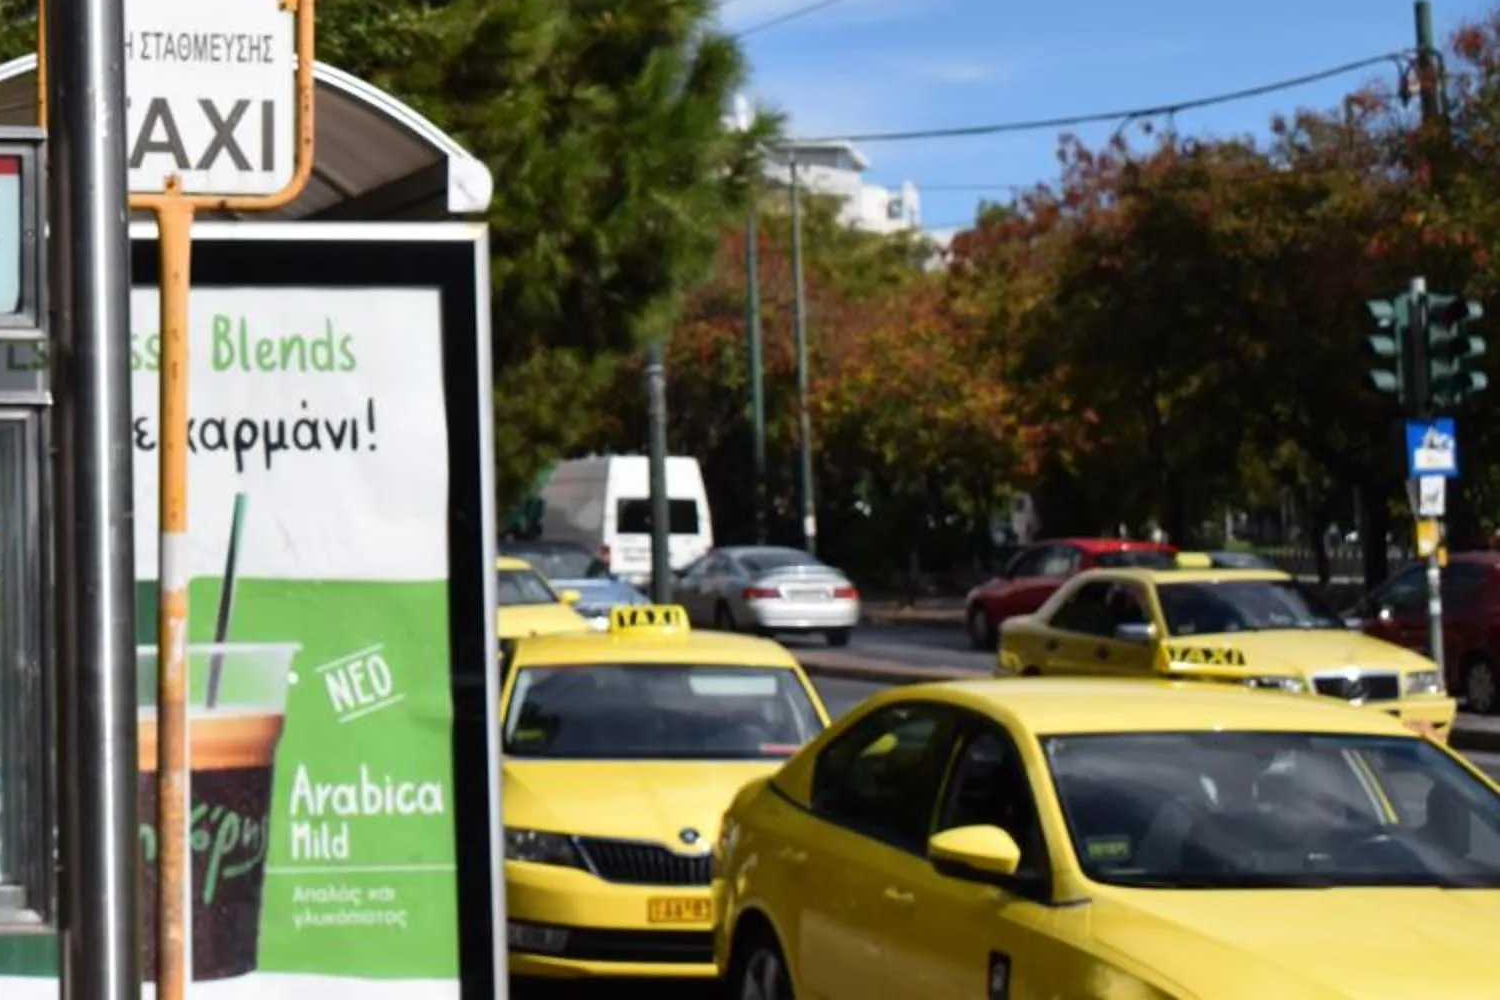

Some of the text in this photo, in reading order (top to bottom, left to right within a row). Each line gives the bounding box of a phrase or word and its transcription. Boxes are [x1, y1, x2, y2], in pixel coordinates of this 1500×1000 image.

[140, 32, 274, 63] ΣΤΑΘΜΕΥΣΗΣ
[128, 97, 275, 172] AXI
[212, 313, 357, 373] Blends
[290, 766, 443, 816] Arabica
[290, 822, 350, 860] Mild
